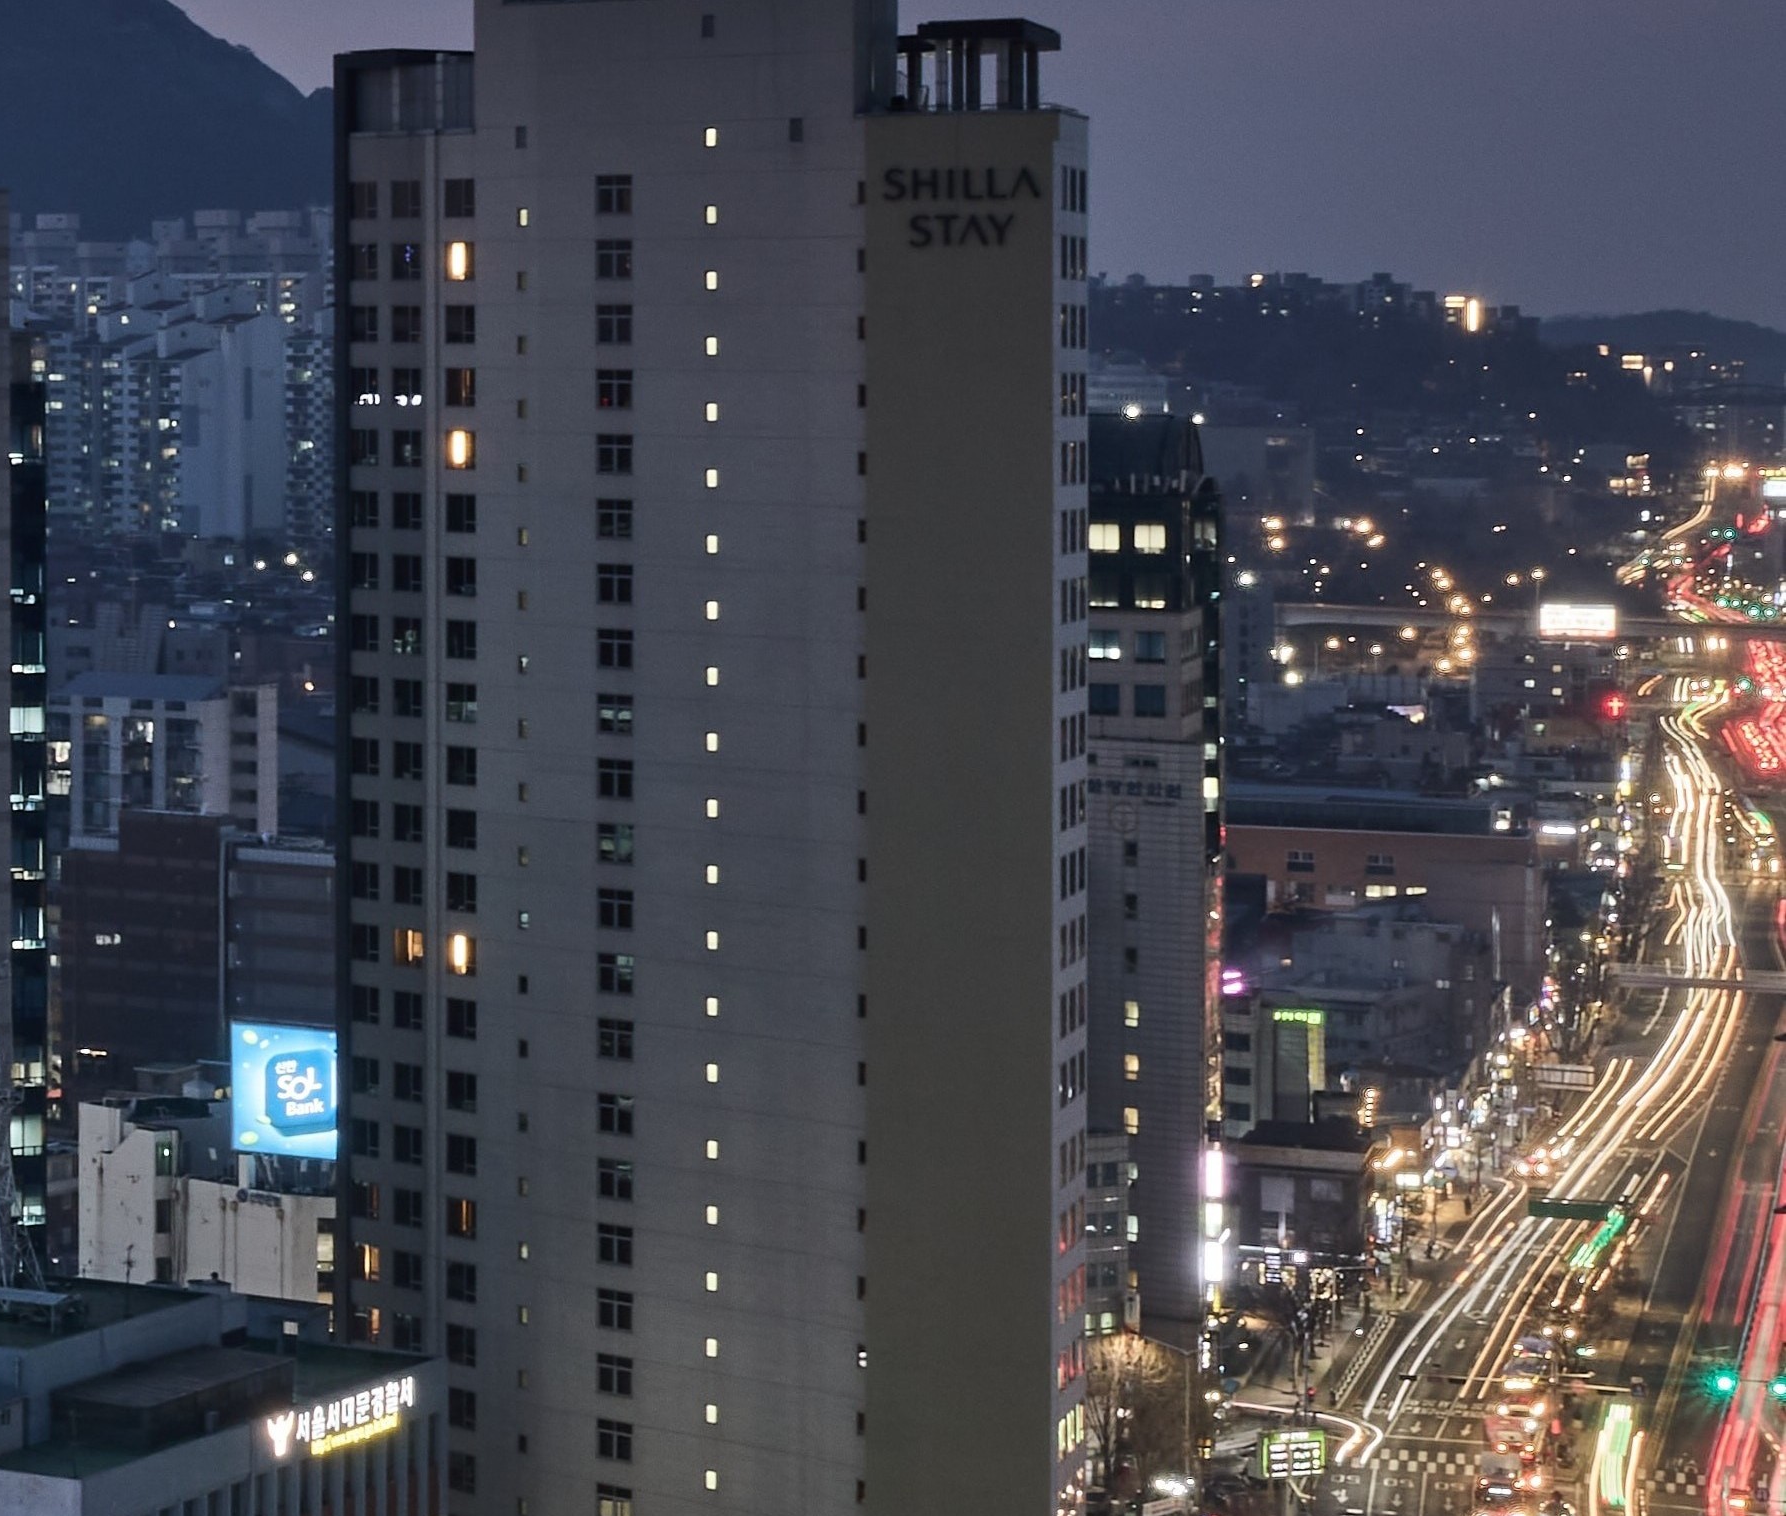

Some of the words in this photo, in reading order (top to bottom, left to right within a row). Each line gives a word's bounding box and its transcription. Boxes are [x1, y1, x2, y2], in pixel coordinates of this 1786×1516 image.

[882, 165, 1041, 201] SHILLA
[908, 213, 1015, 248] STAY
[285, 1097, 326, 1118] Bank
